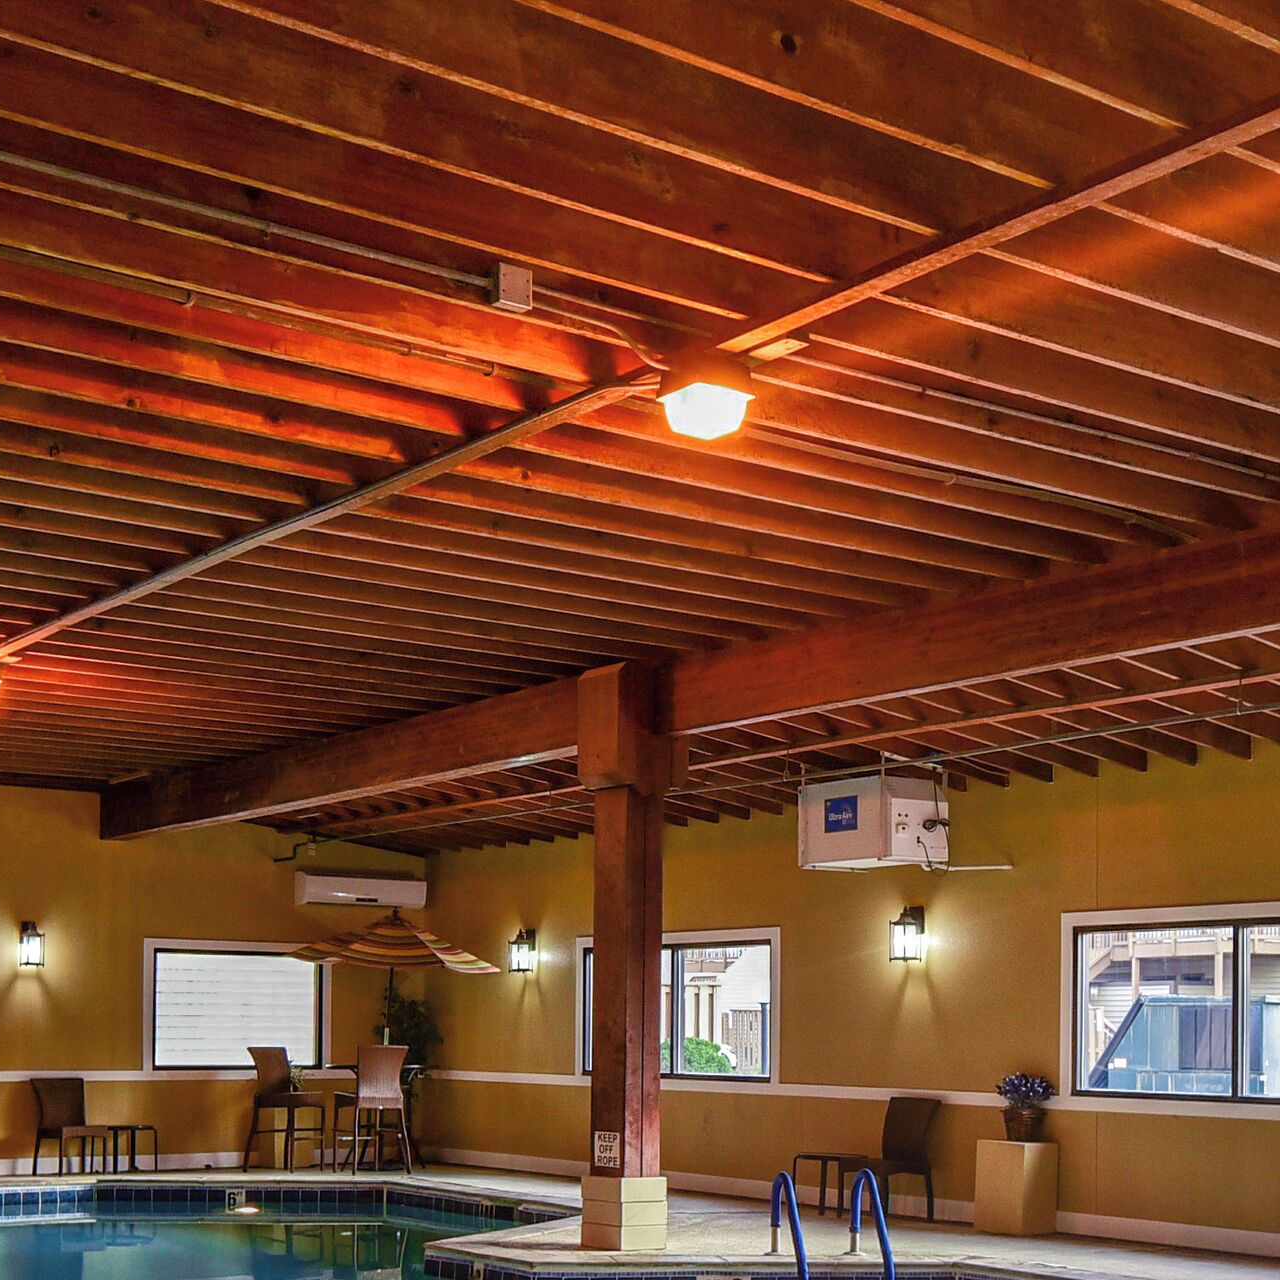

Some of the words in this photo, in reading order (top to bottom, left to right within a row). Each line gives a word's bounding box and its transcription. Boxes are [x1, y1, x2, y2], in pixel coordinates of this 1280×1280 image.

[597, 1133, 618, 1143] KEEP
[598, 1144, 614, 1154] OFF
[597, 1155, 618, 1166] ROPE
